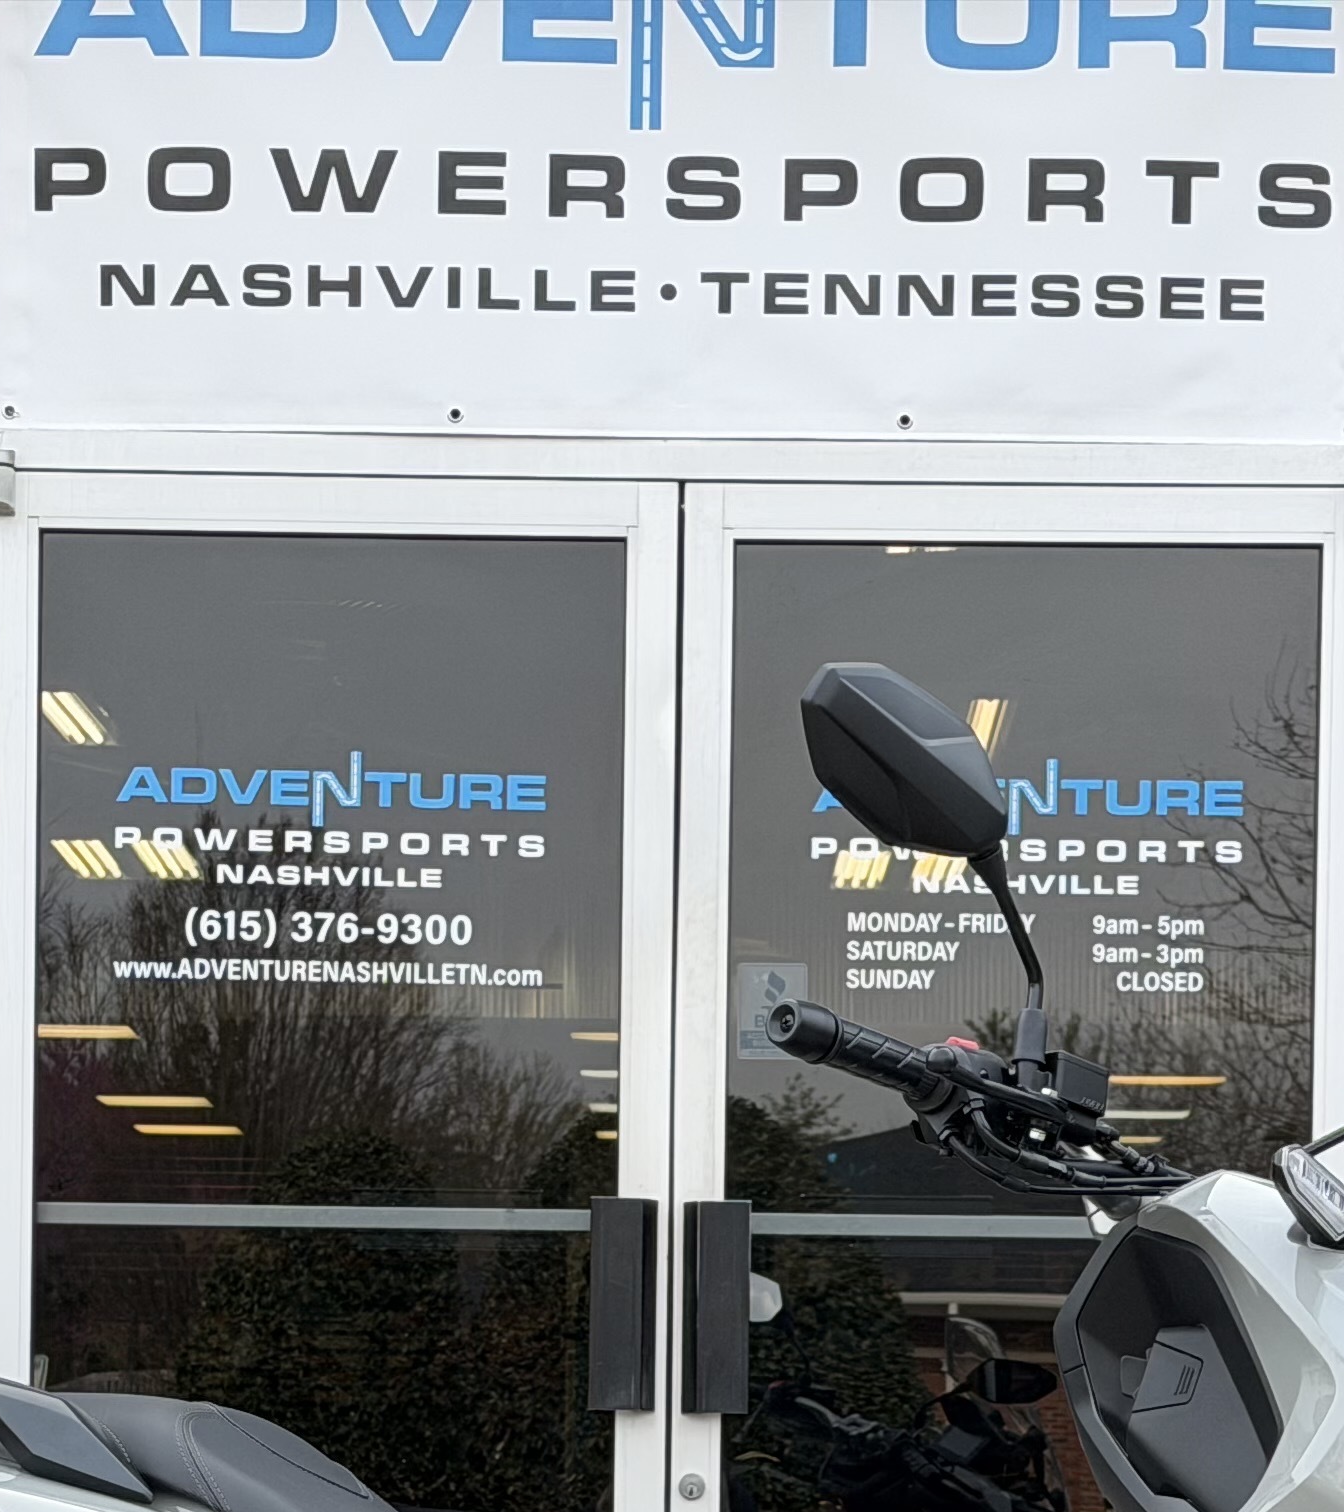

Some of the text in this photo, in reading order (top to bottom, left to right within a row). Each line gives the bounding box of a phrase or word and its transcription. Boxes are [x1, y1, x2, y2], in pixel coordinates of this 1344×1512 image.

[36, 0, 1336, 130] ADVENTURE
[34, 147, 1332, 229] POWERSPORTS
[99, 264, 1265, 321] NASHVILLE TENNESSEE
[116, 751, 547, 827] ADVENTURE
[813, 759, 1244, 835] NTURE
[113, 826, 545, 859] POWERSPORTS
[215, 863, 444, 889] NASHVILLE
[184, 907, 473, 949] (615) 376-9300
[846, 939, 960, 962] SATURDAY
[113, 958, 544, 988] www.ADVENTURENASHVILLETN.com
[846, 968, 1205, 992] SUNDAY CLOSED
